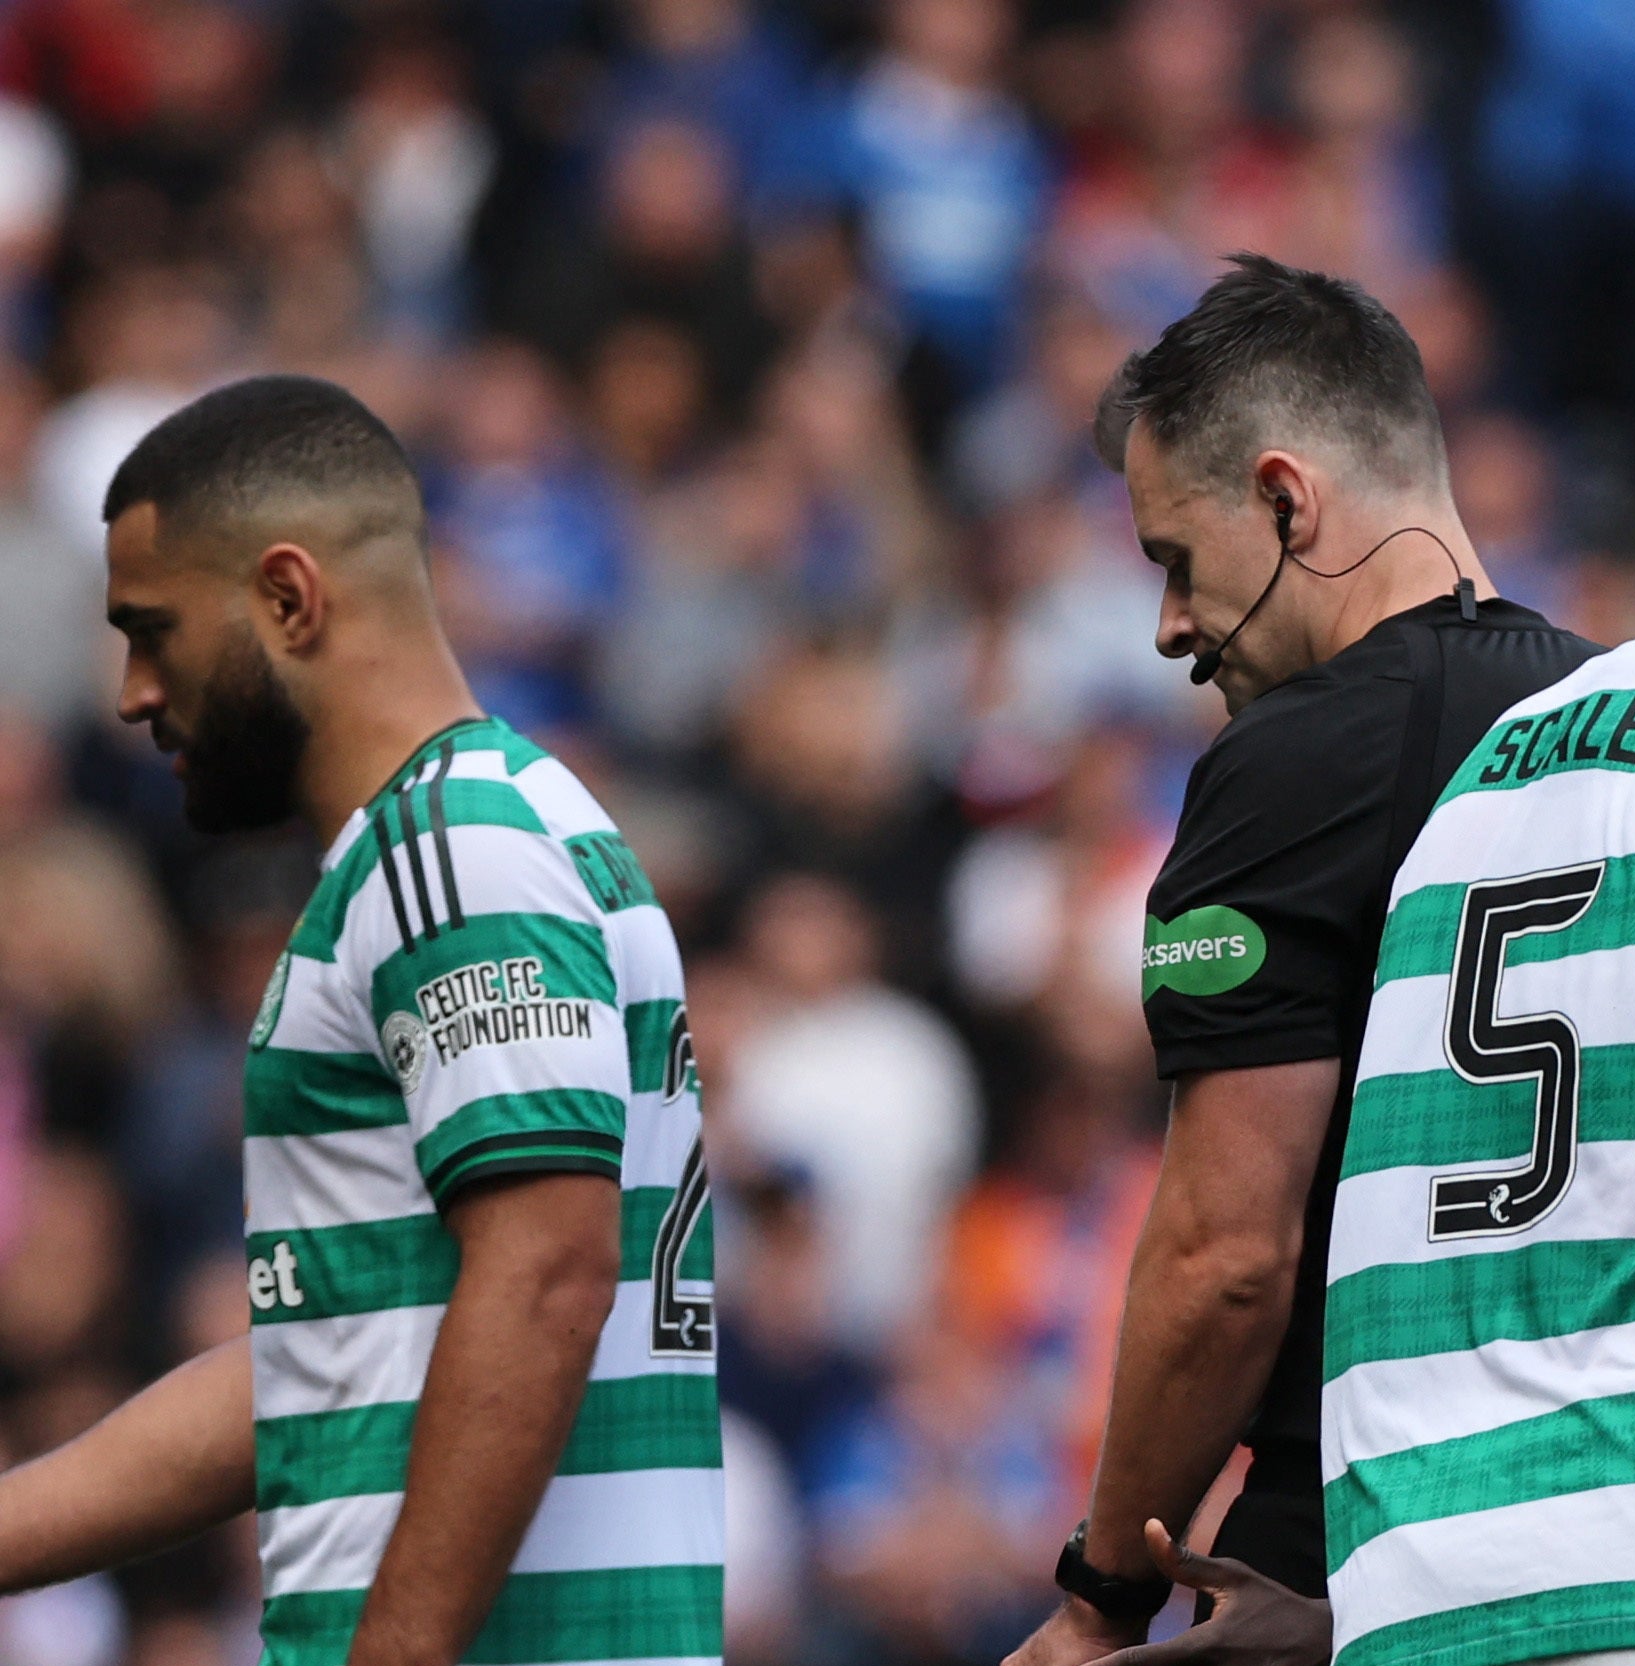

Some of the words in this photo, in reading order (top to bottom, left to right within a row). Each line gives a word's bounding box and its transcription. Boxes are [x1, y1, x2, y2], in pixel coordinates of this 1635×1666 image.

[419, 965, 498, 1025] CELTIC
[505, 960, 542, 1000] FC
[432, 1003, 592, 1067] FOUNDATION
[1428, 860, 1604, 1243] 5
